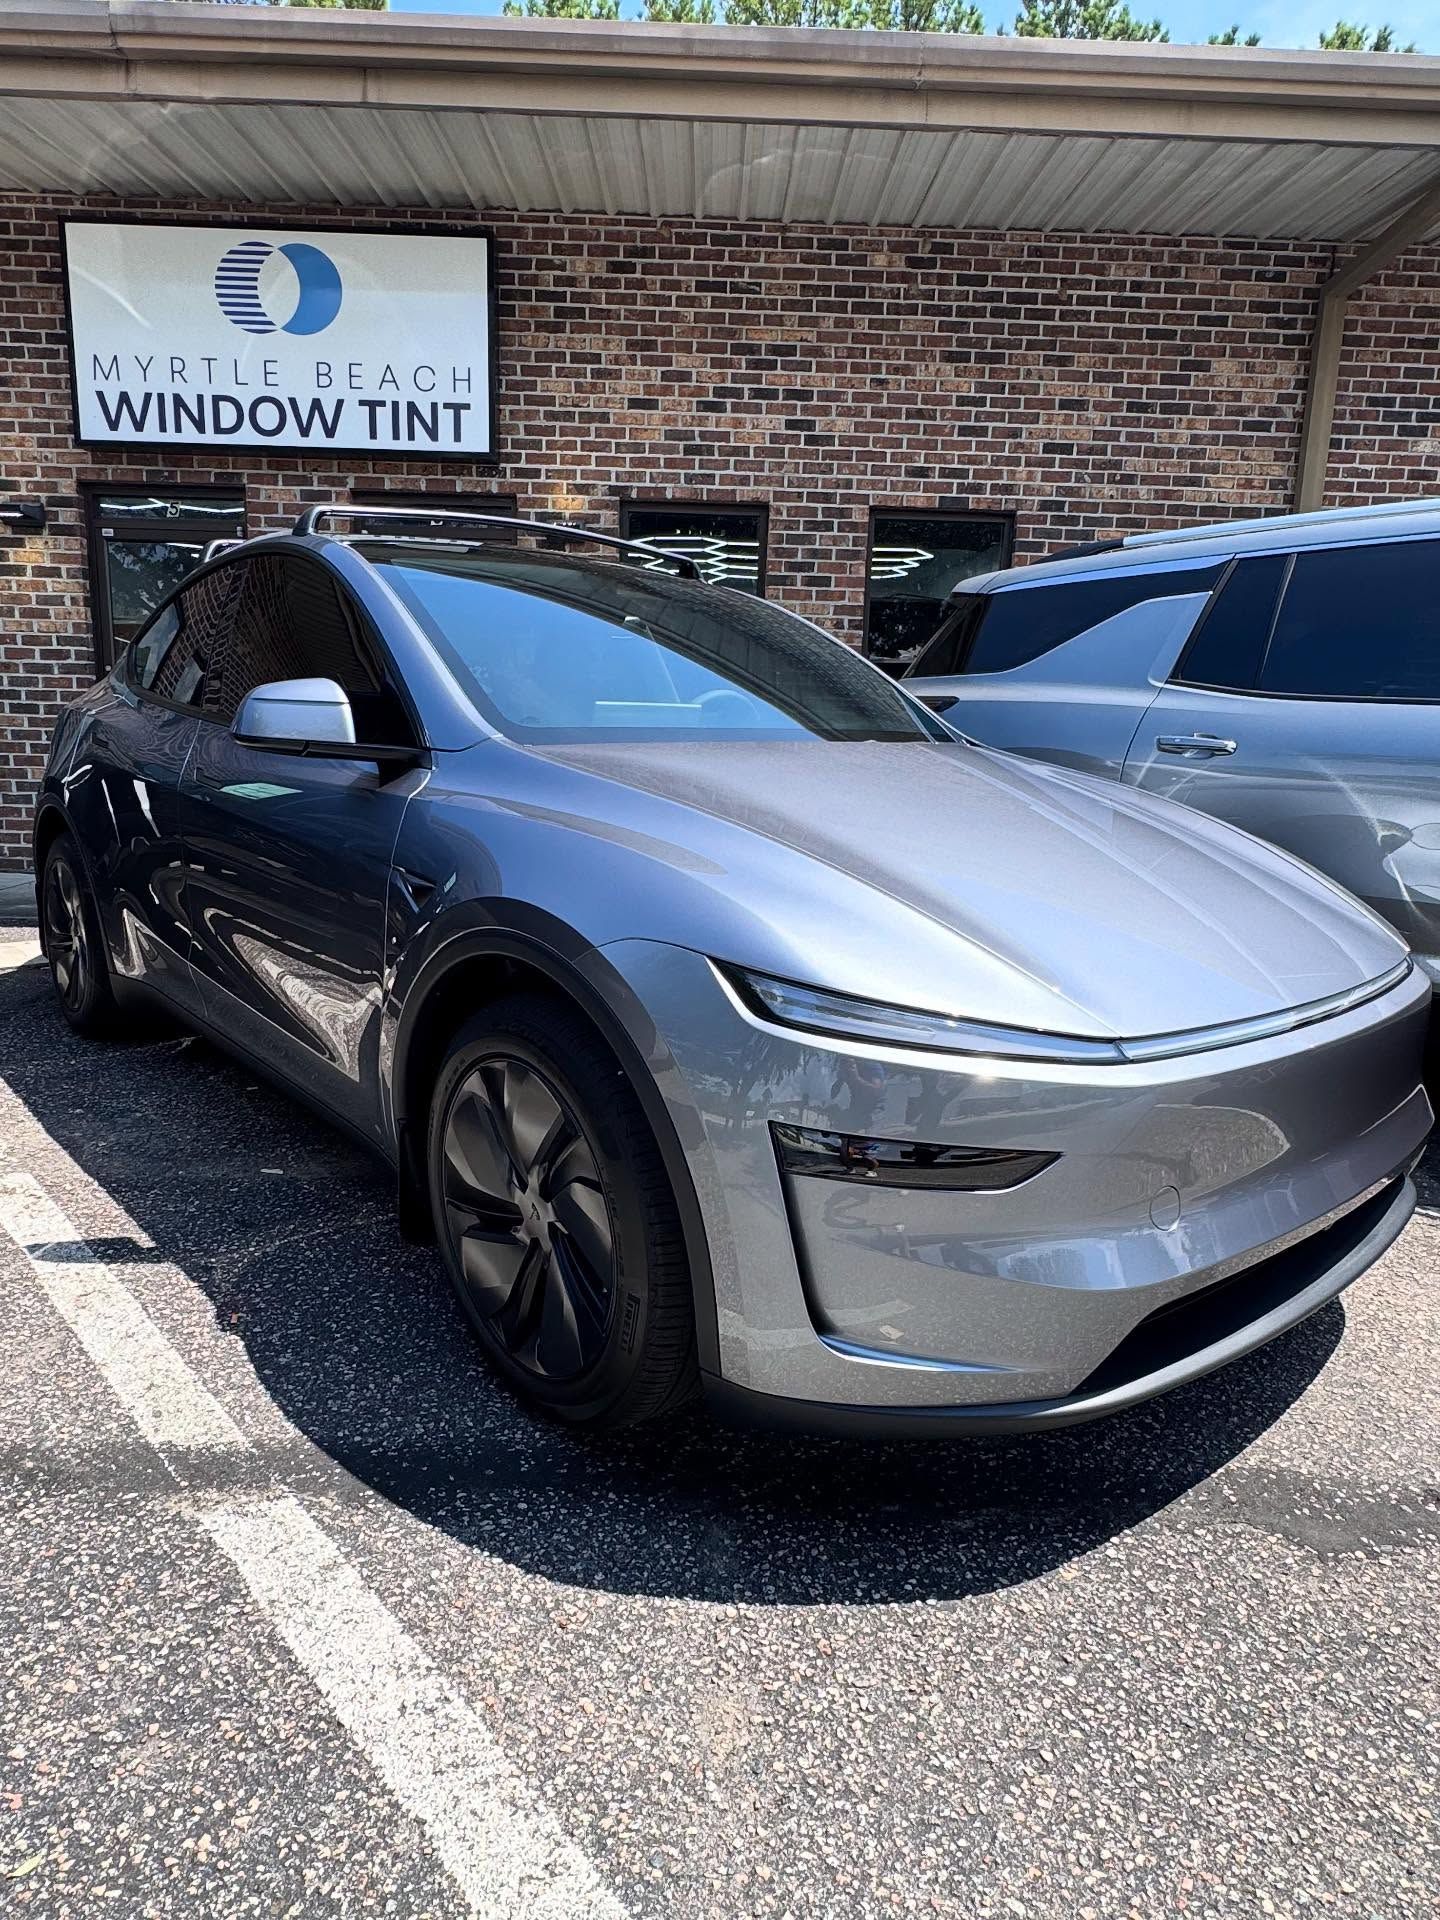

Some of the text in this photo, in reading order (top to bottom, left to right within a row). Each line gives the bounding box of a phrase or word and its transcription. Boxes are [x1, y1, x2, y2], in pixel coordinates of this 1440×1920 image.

[93, 354, 471, 393] MYRTLE BEACH
[95, 390, 471, 443] WINDOW TINT
[168, 502, 179, 516] 5
